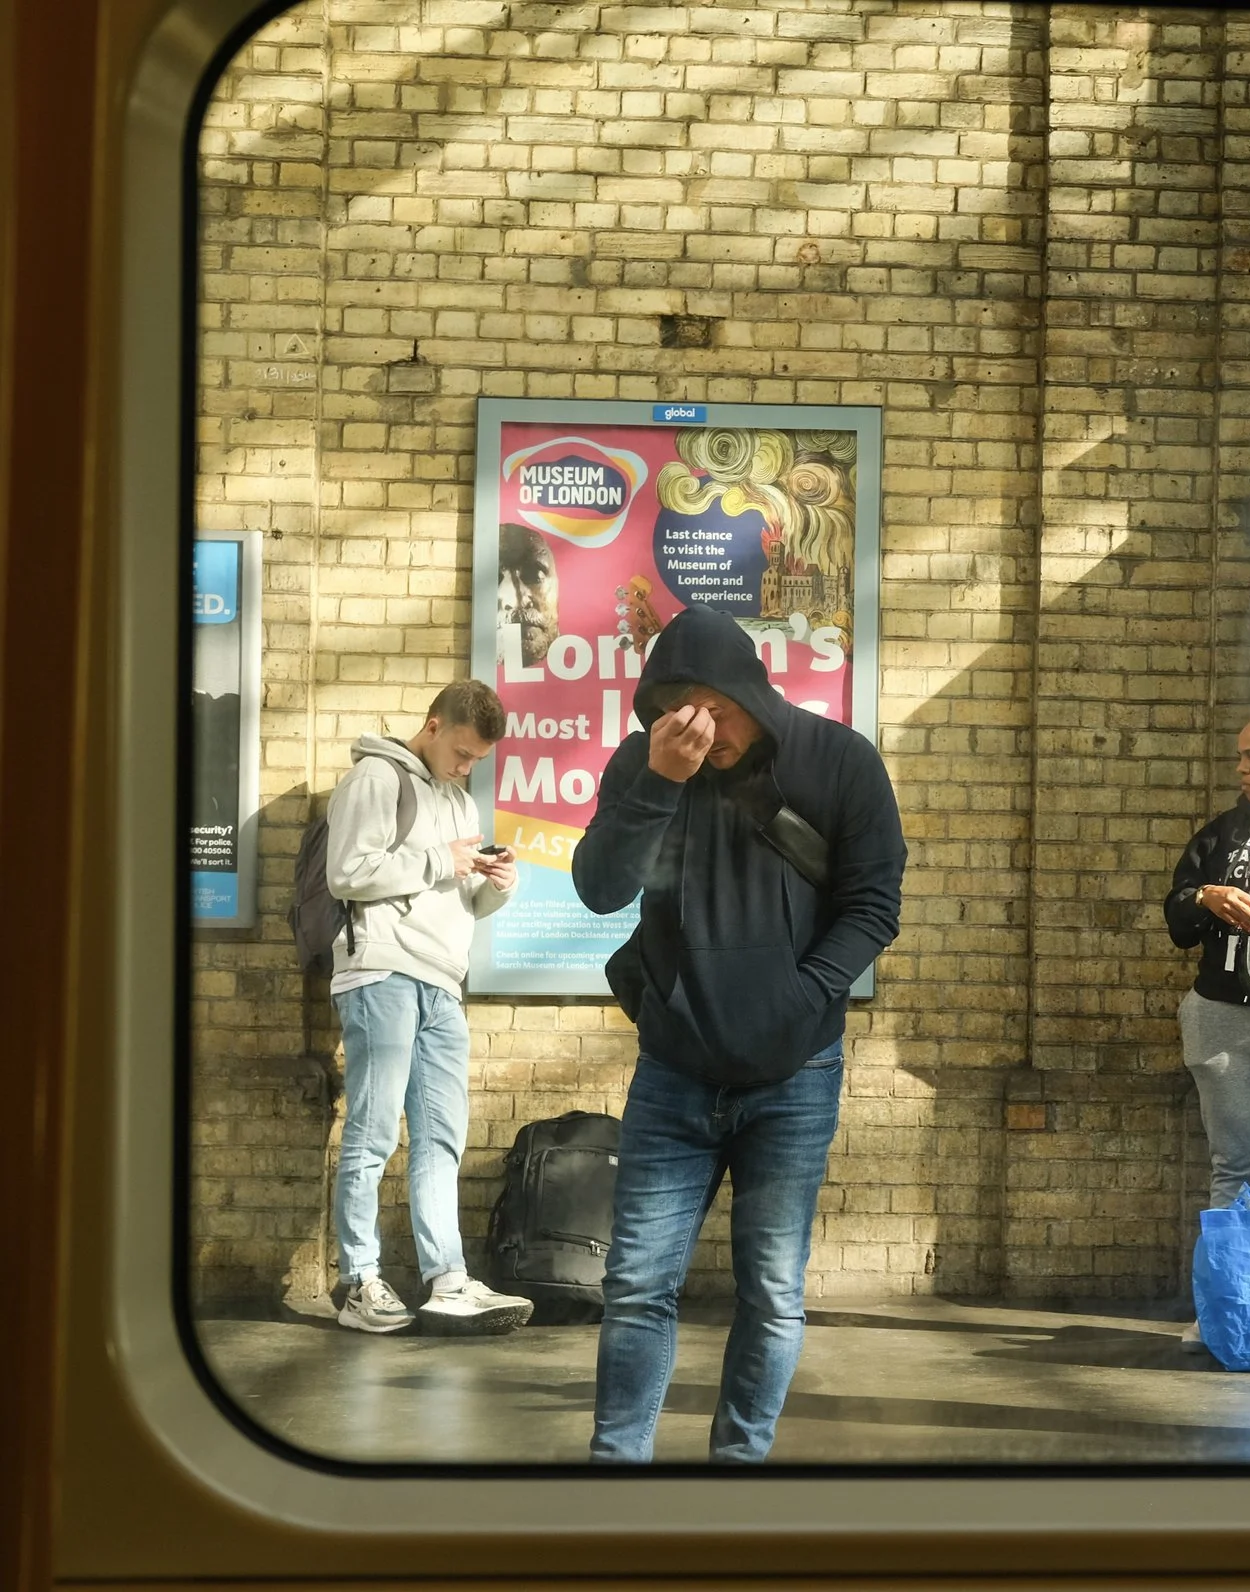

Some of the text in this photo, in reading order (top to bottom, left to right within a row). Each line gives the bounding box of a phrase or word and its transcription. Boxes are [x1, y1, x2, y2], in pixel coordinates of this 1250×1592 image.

[664, 407, 696, 420] global
[519, 466, 604, 486] MUSEUM
[519, 485, 622, 506] OF LONDON
[665, 529, 733, 541] Last chance
[662, 544, 725, 555] to visit the
[667, 559, 733, 571] Museum of
[678, 574, 743, 586] London and
[690, 590, 753, 603] experience
[503, 612, 844, 683] Lonn's
[504, 711, 591, 741] Most
[195, 837, 208, 846] For
[513, 826, 579, 860] LAST
[208, 858, 224, 866] sort
[520, 919, 552, 930] exciting
[552, 919, 591, 929] relocation
[592, 920, 601, 929] to
[602, 920, 622, 929] West
[496, 930, 530, 938] Museum
[531, 930, 540, 939] of
[541, 930, 570, 939] London
[571, 931, 609, 940] Docklands
[496, 951, 520, 959] Check
[520, 951, 544, 959] online
[545, 951, 557, 959] for
[558, 952, 595, 961] upcoming
[496, 961, 604, 970] Search Museum of London to
